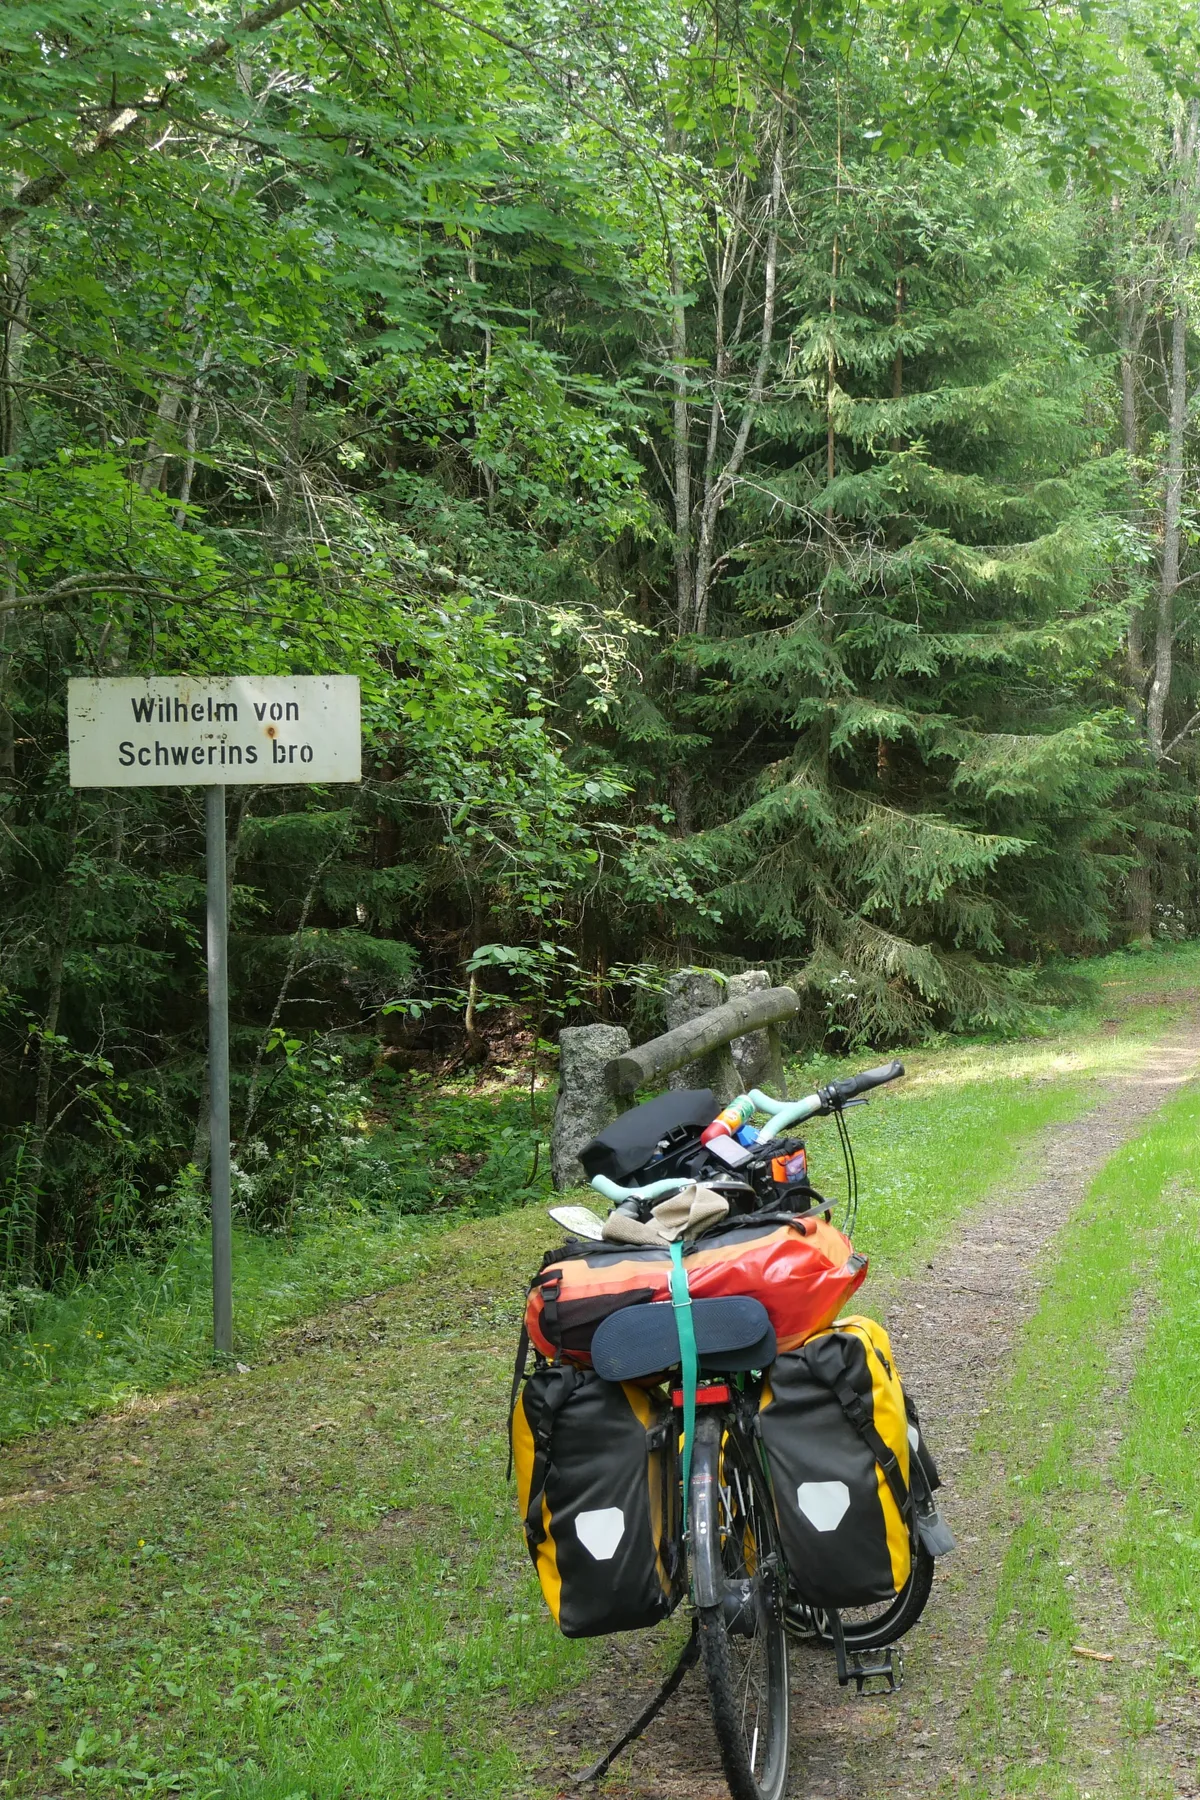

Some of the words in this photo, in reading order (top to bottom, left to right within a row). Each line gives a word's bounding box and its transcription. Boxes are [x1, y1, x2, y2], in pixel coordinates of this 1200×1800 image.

[131, 696, 238, 723] Wilhelm
[253, 701, 299, 722] von
[118, 739, 259, 767] Schwerins
[272, 738, 314, 764] bro
